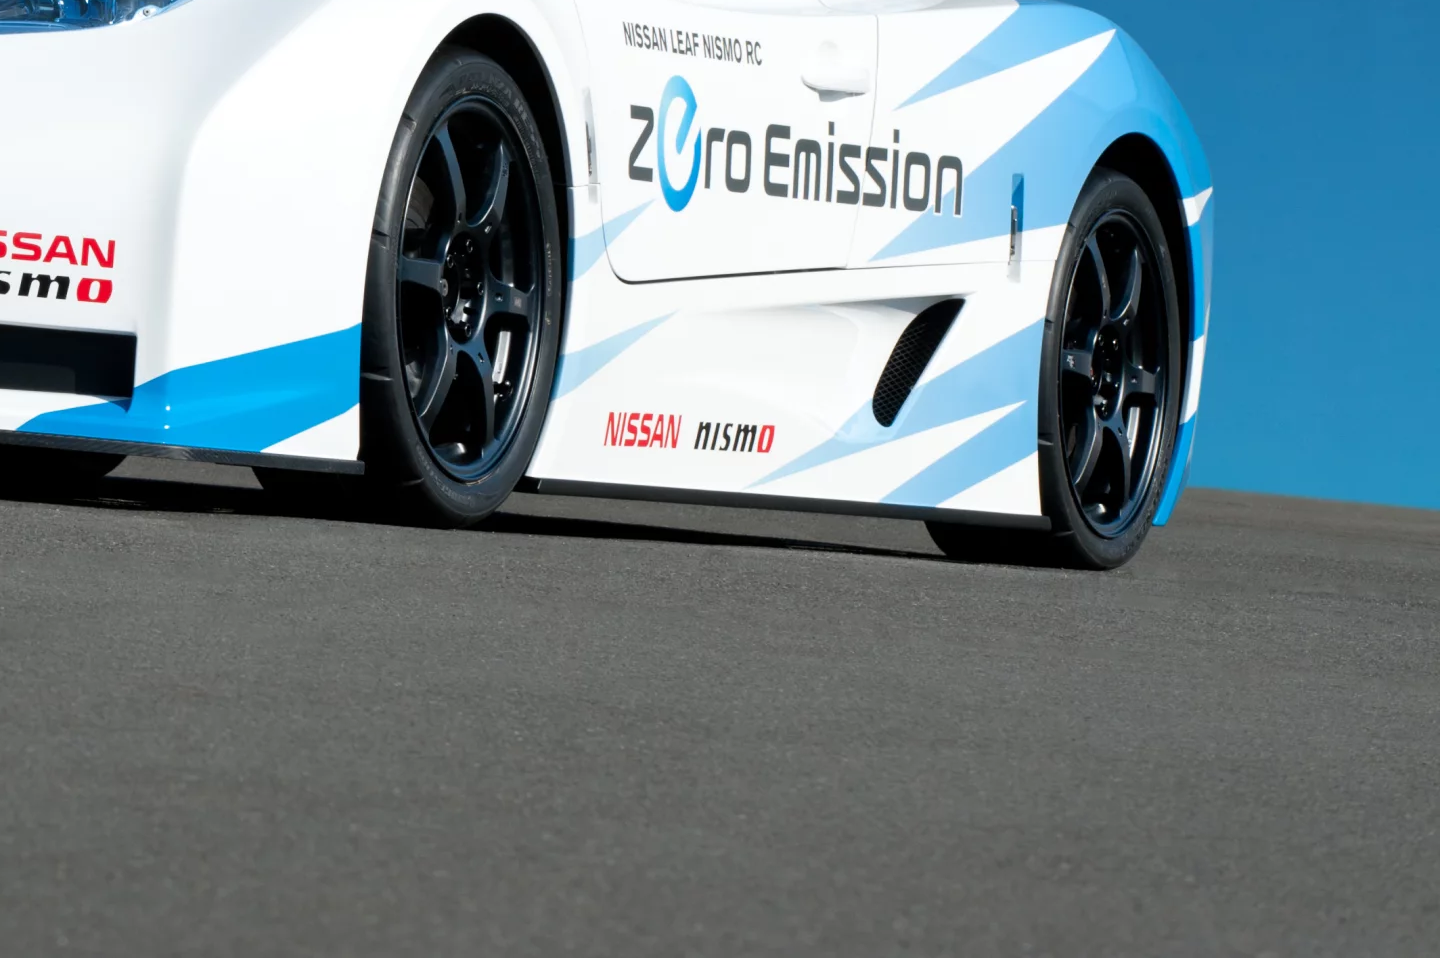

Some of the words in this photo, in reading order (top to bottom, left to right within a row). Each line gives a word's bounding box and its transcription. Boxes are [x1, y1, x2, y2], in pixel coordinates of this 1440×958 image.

[622, 21, 668, 52] NISSAN
[669, 29, 700, 57] LEAF
[702, 33, 743, 64] NISMO
[745, 40, 763, 67] RC
[763, 121, 963, 216] Emission
[603, 411, 683, 449] NISSAN
[693, 421, 776, 454] nismo
